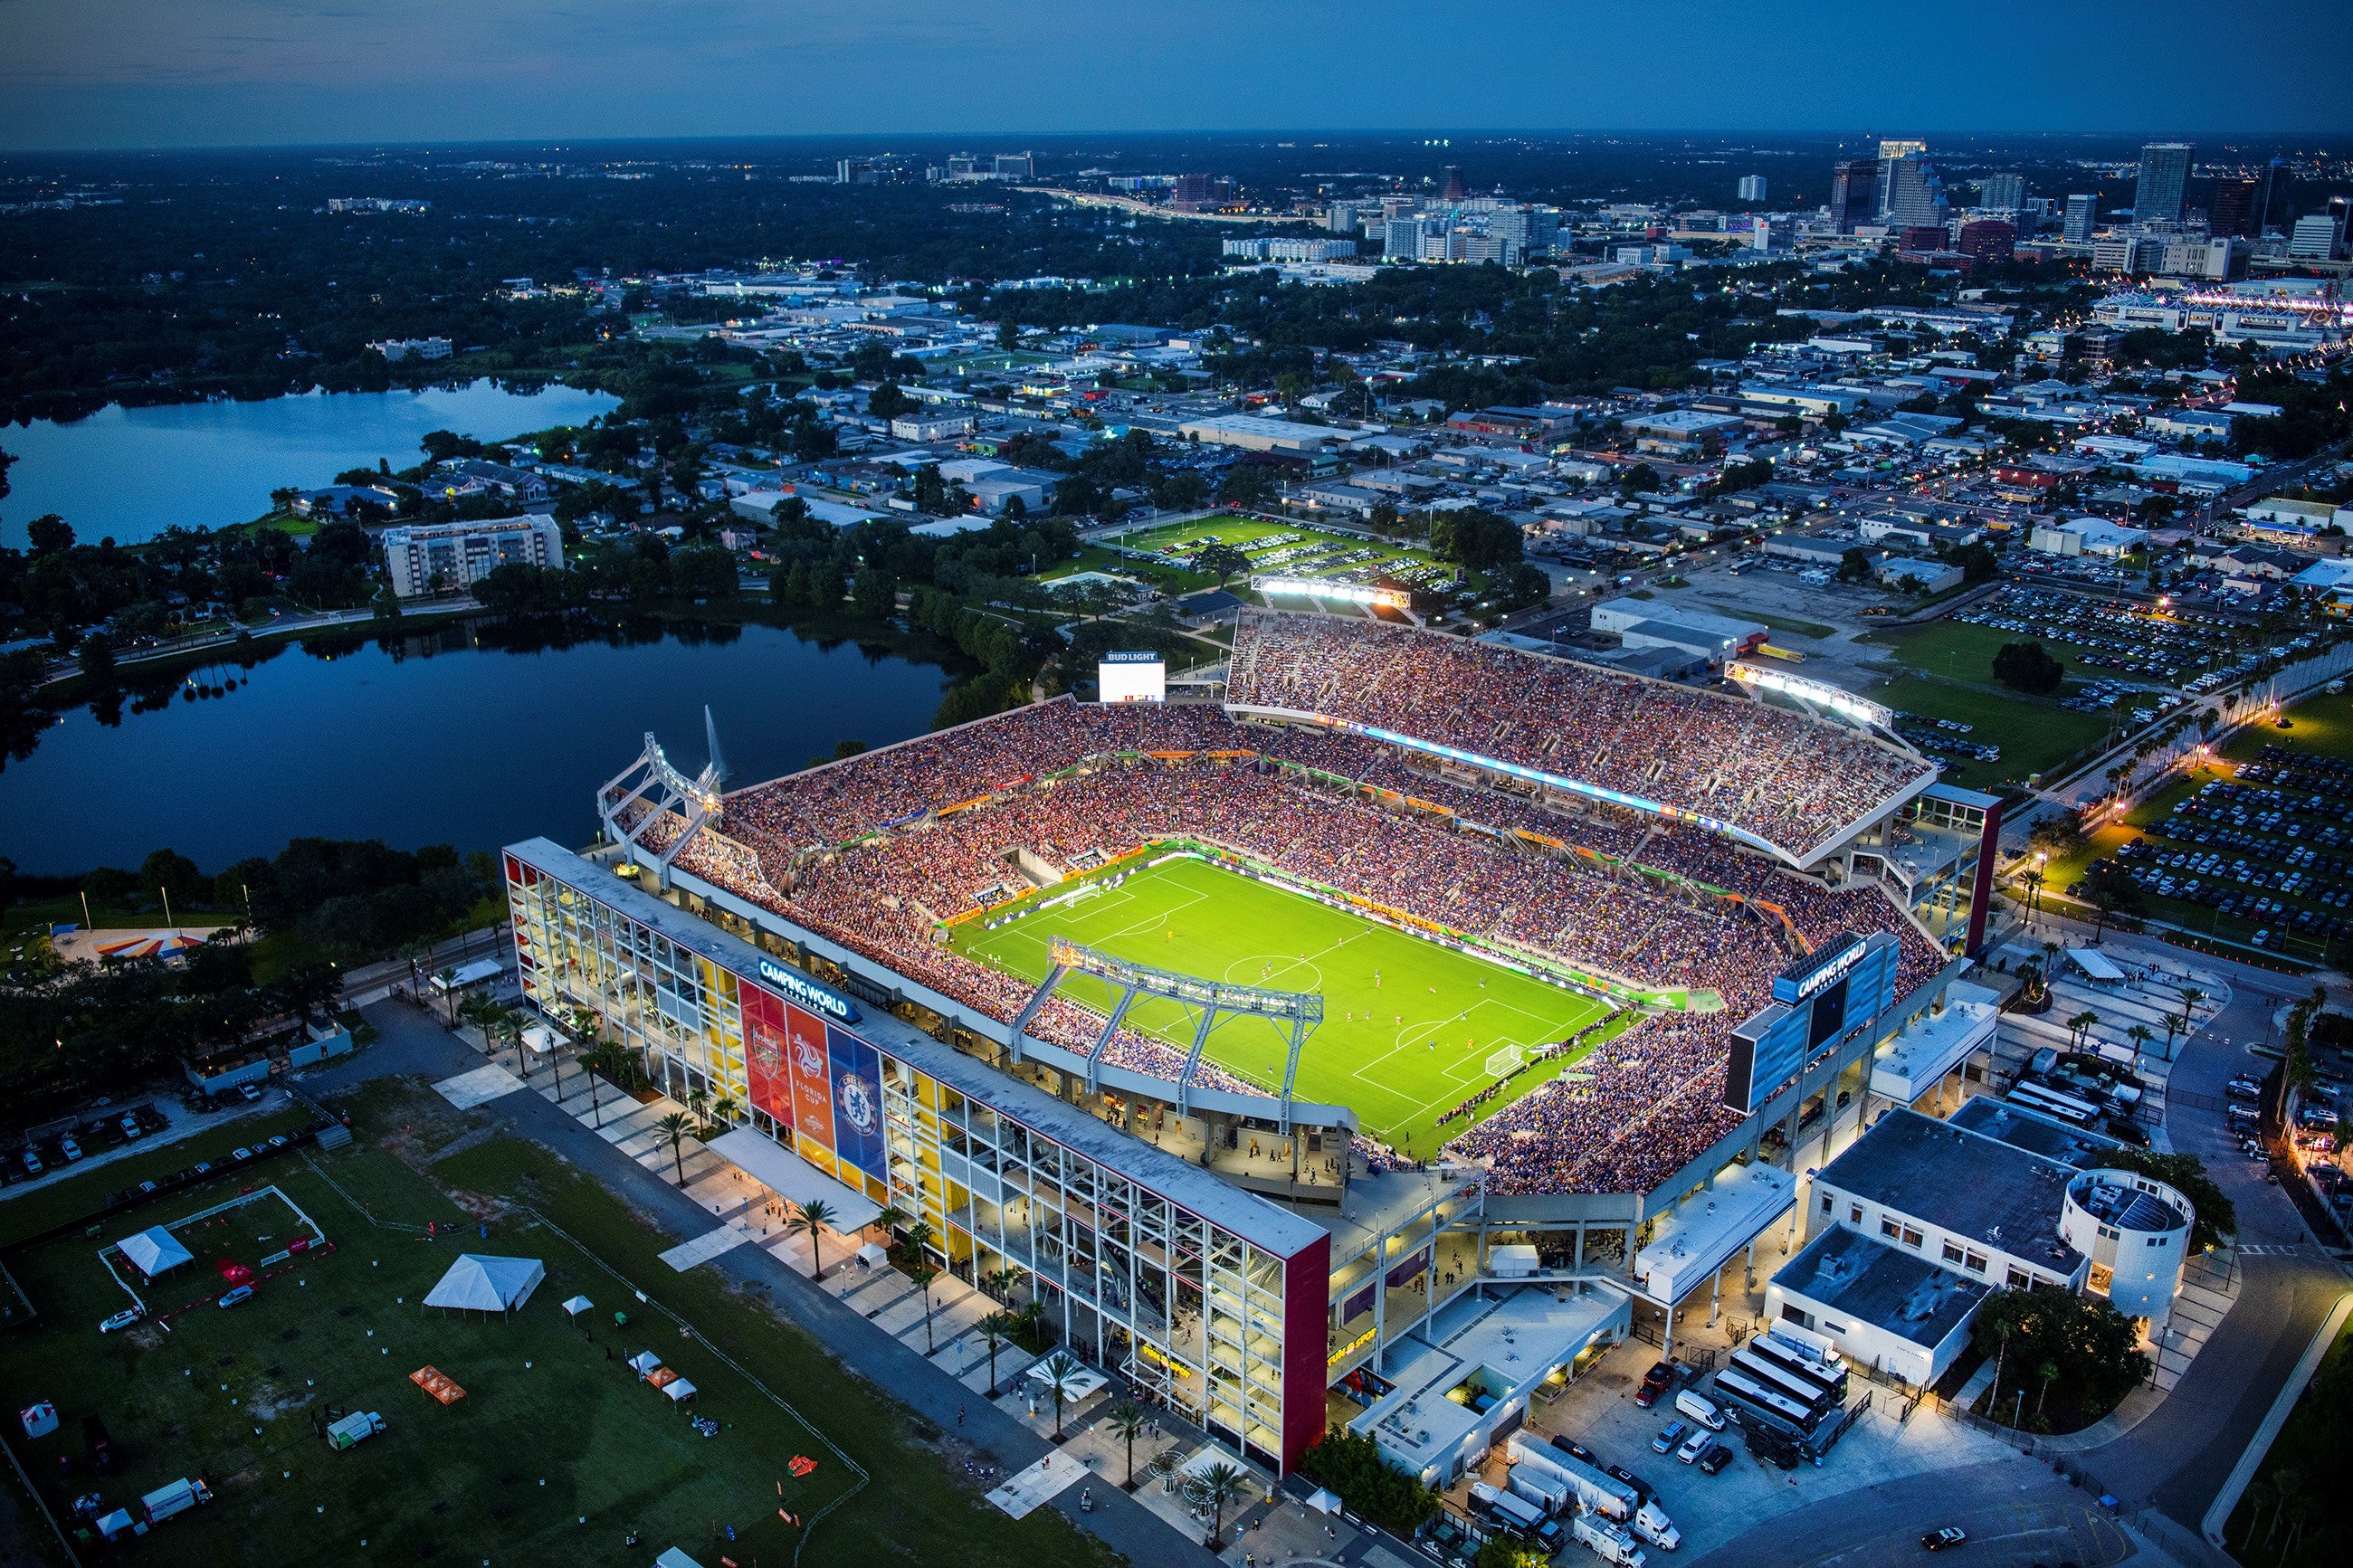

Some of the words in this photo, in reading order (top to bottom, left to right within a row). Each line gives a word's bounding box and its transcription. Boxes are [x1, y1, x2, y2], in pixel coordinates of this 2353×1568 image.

[1108, 653, 1128, 661] BUD
[1129, 653, 1156, 661] LIGHT
[1798, 961, 1836, 998] CAMPING
[1837, 941, 1866, 972] WORLD
[760, 961, 807, 996] CAMPING
[806, 984, 847, 1016] WORLD
[796, 1079, 827, 1104] FLORIDA
[805, 1093, 820, 1106] CUP
[1327, 1346, 1347, 1368] FUN
[1355, 1326, 1377, 1349] SPOT
